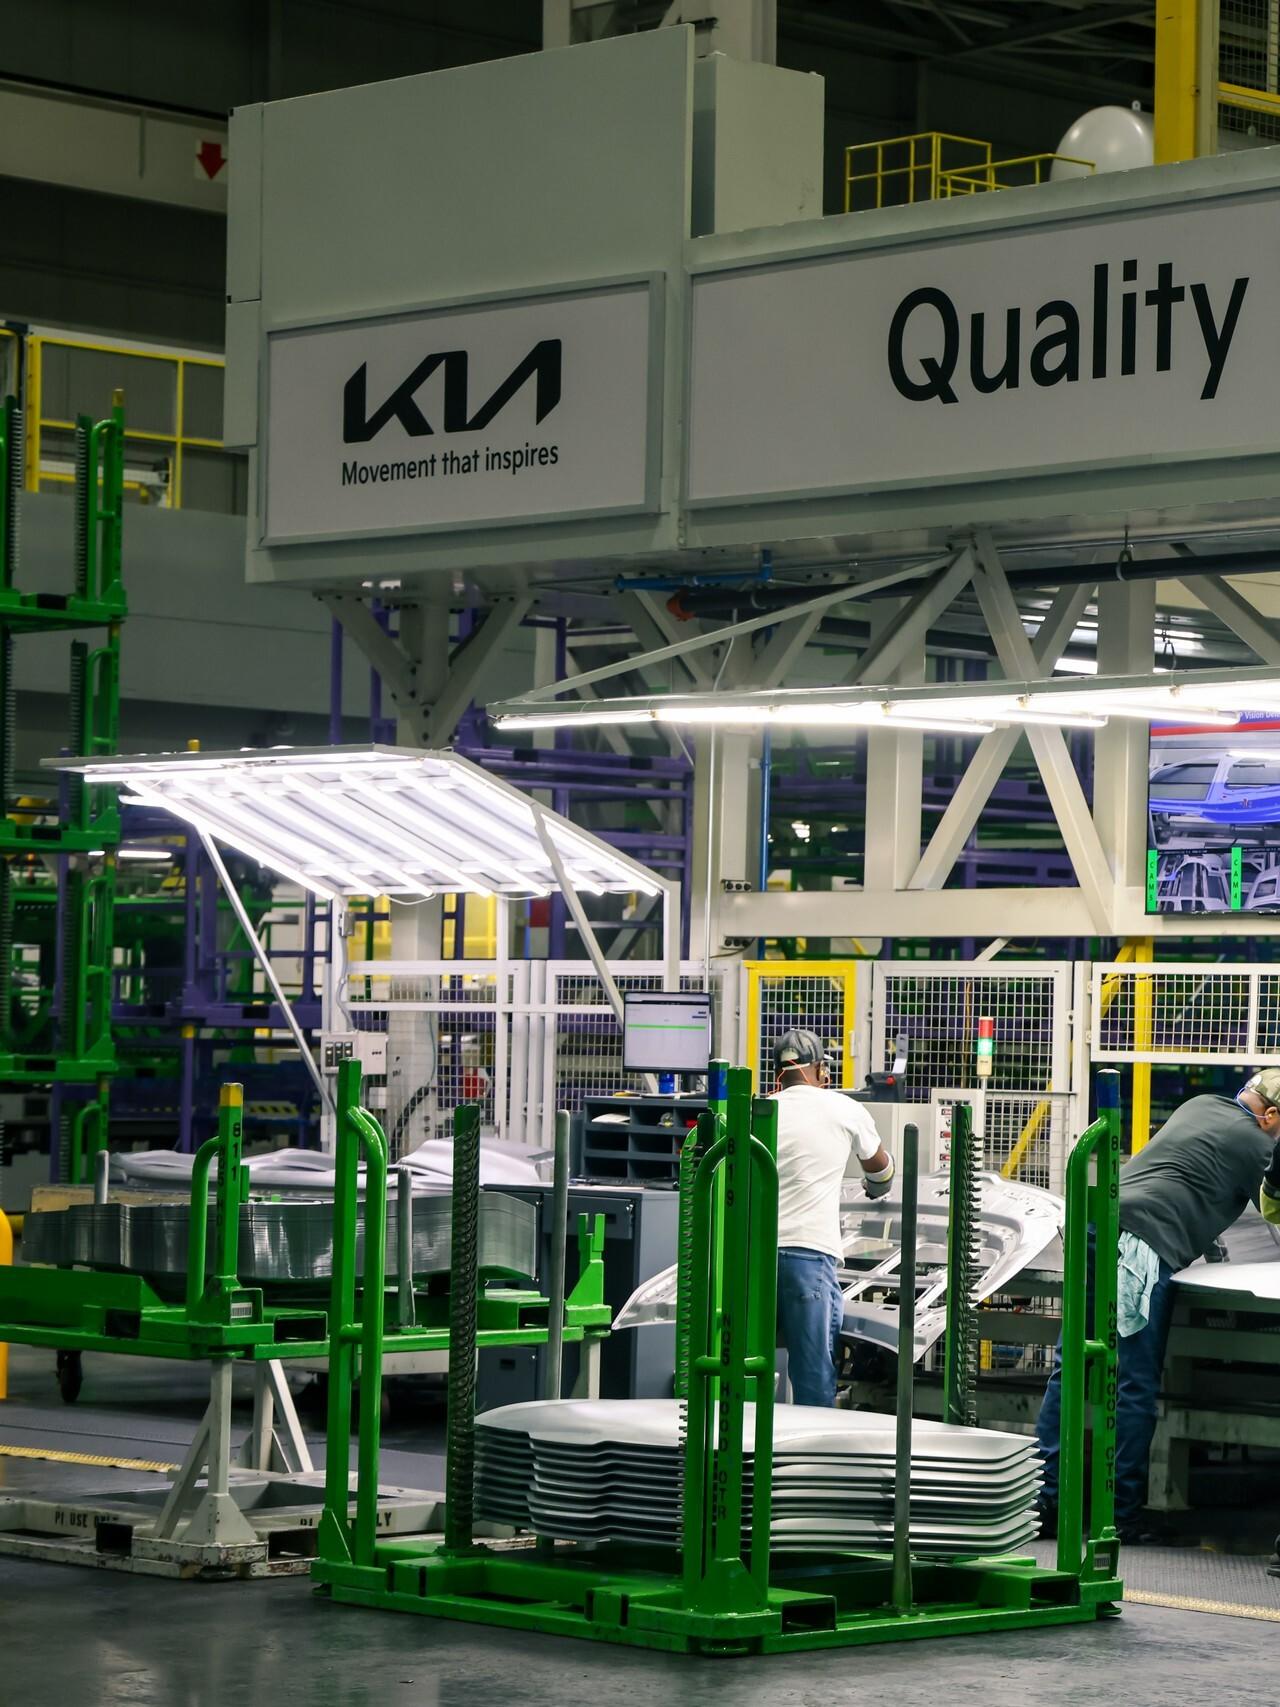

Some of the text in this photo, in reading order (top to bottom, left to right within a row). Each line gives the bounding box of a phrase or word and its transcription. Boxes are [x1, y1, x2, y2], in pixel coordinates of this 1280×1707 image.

[887, 258, 1250, 405] Quality
[342, 338, 563, 444] KIA
[341, 442, 560, 486] Movement that inspires
[231, 1121, 241, 1182] 811
[727, 1137, 735, 1207] 819
[1110, 1135, 1118, 1200] 819
[719, 1382, 729, 1451] HOOD
[1106, 1364, 1116, 1431] HOOD
[70, 1512, 88, 1528] USE
